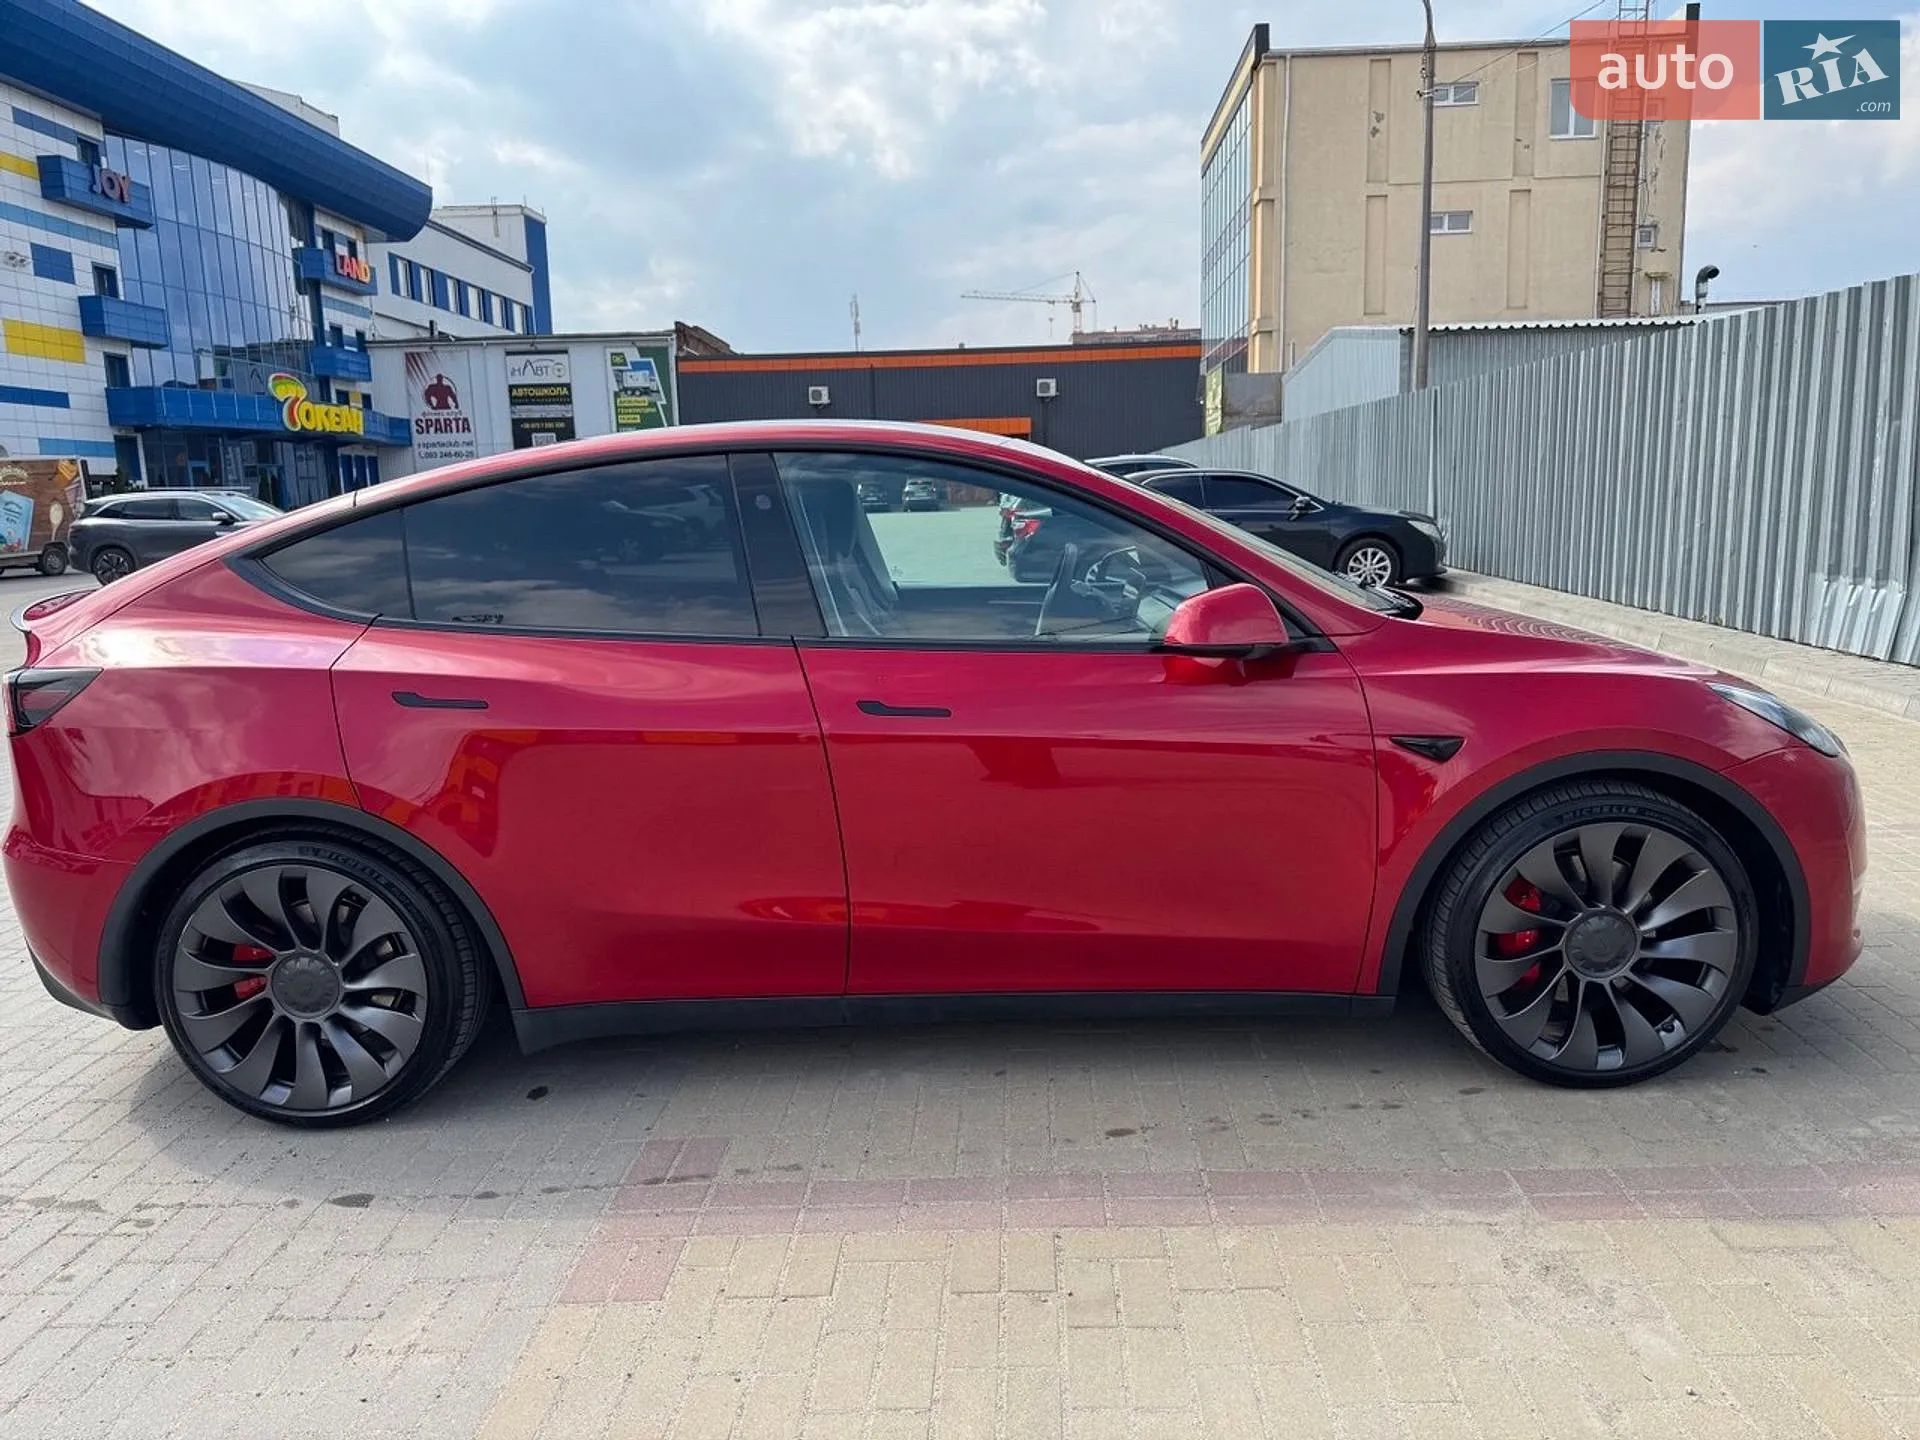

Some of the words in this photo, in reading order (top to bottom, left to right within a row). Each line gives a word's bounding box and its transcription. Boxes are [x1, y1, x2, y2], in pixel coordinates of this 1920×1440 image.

[92, 163, 131, 204] JOY
[335, 252, 371, 284] LAND
[511, 387, 570, 397] АВТОШКОЛА
[415, 417, 471, 435] SPARTA
